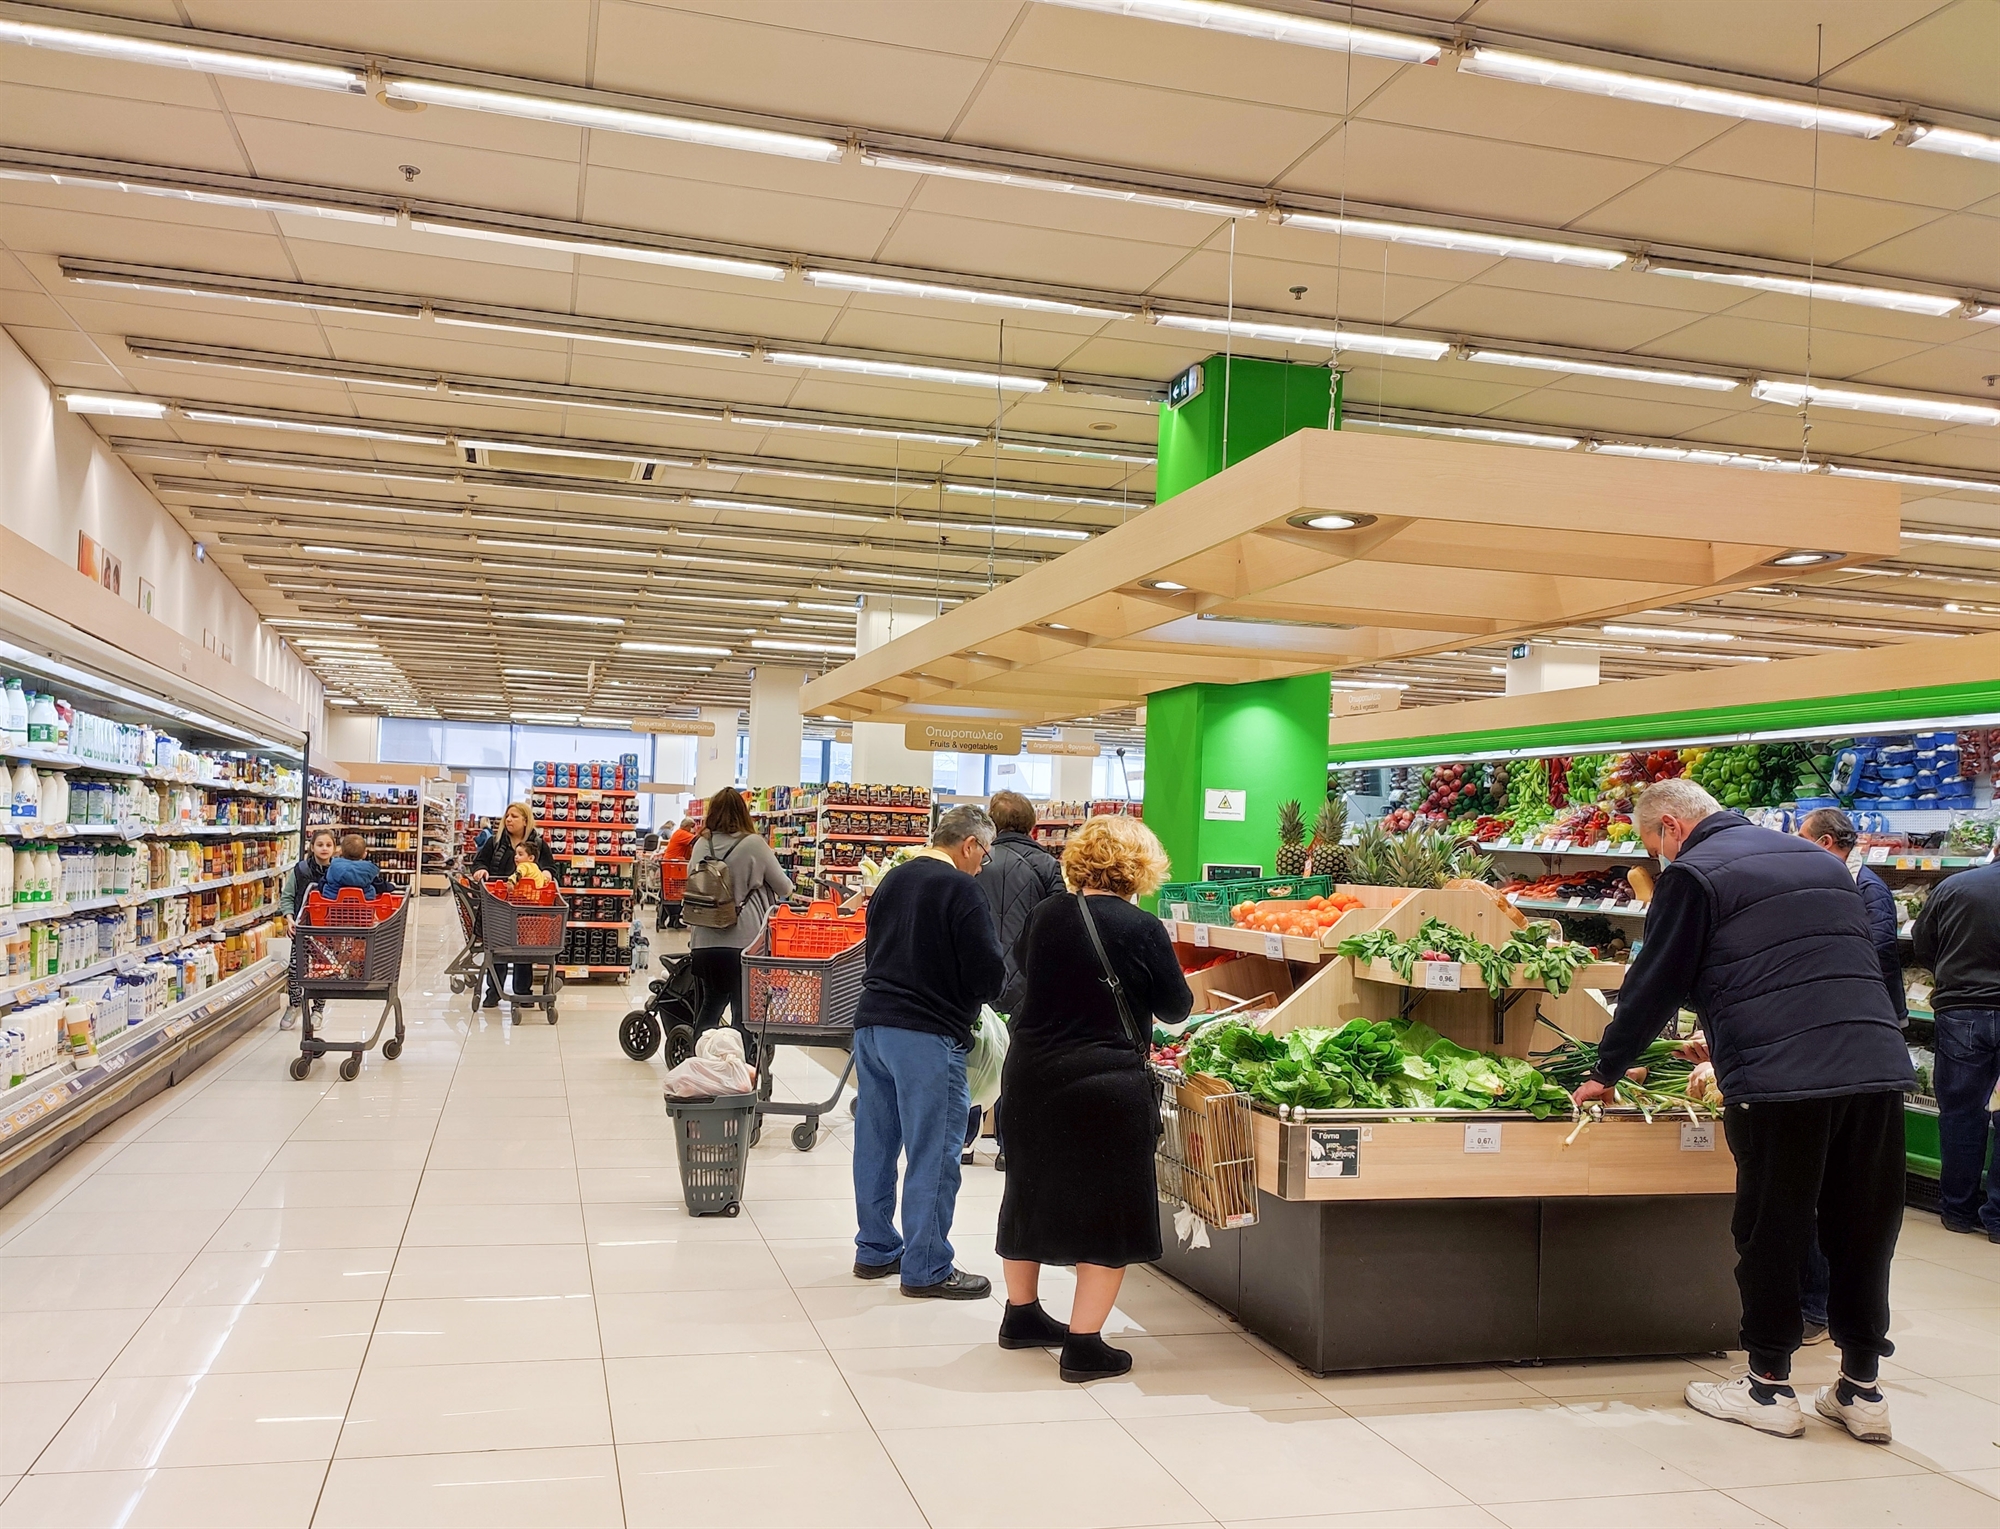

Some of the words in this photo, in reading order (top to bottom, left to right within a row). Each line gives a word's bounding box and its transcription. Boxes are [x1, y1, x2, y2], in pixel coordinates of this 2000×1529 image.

[925, 726, 1003, 740] Οπωροπωλείο
[930, 740, 950, 748] Fruits
[960, 743, 998, 751] vegetables
